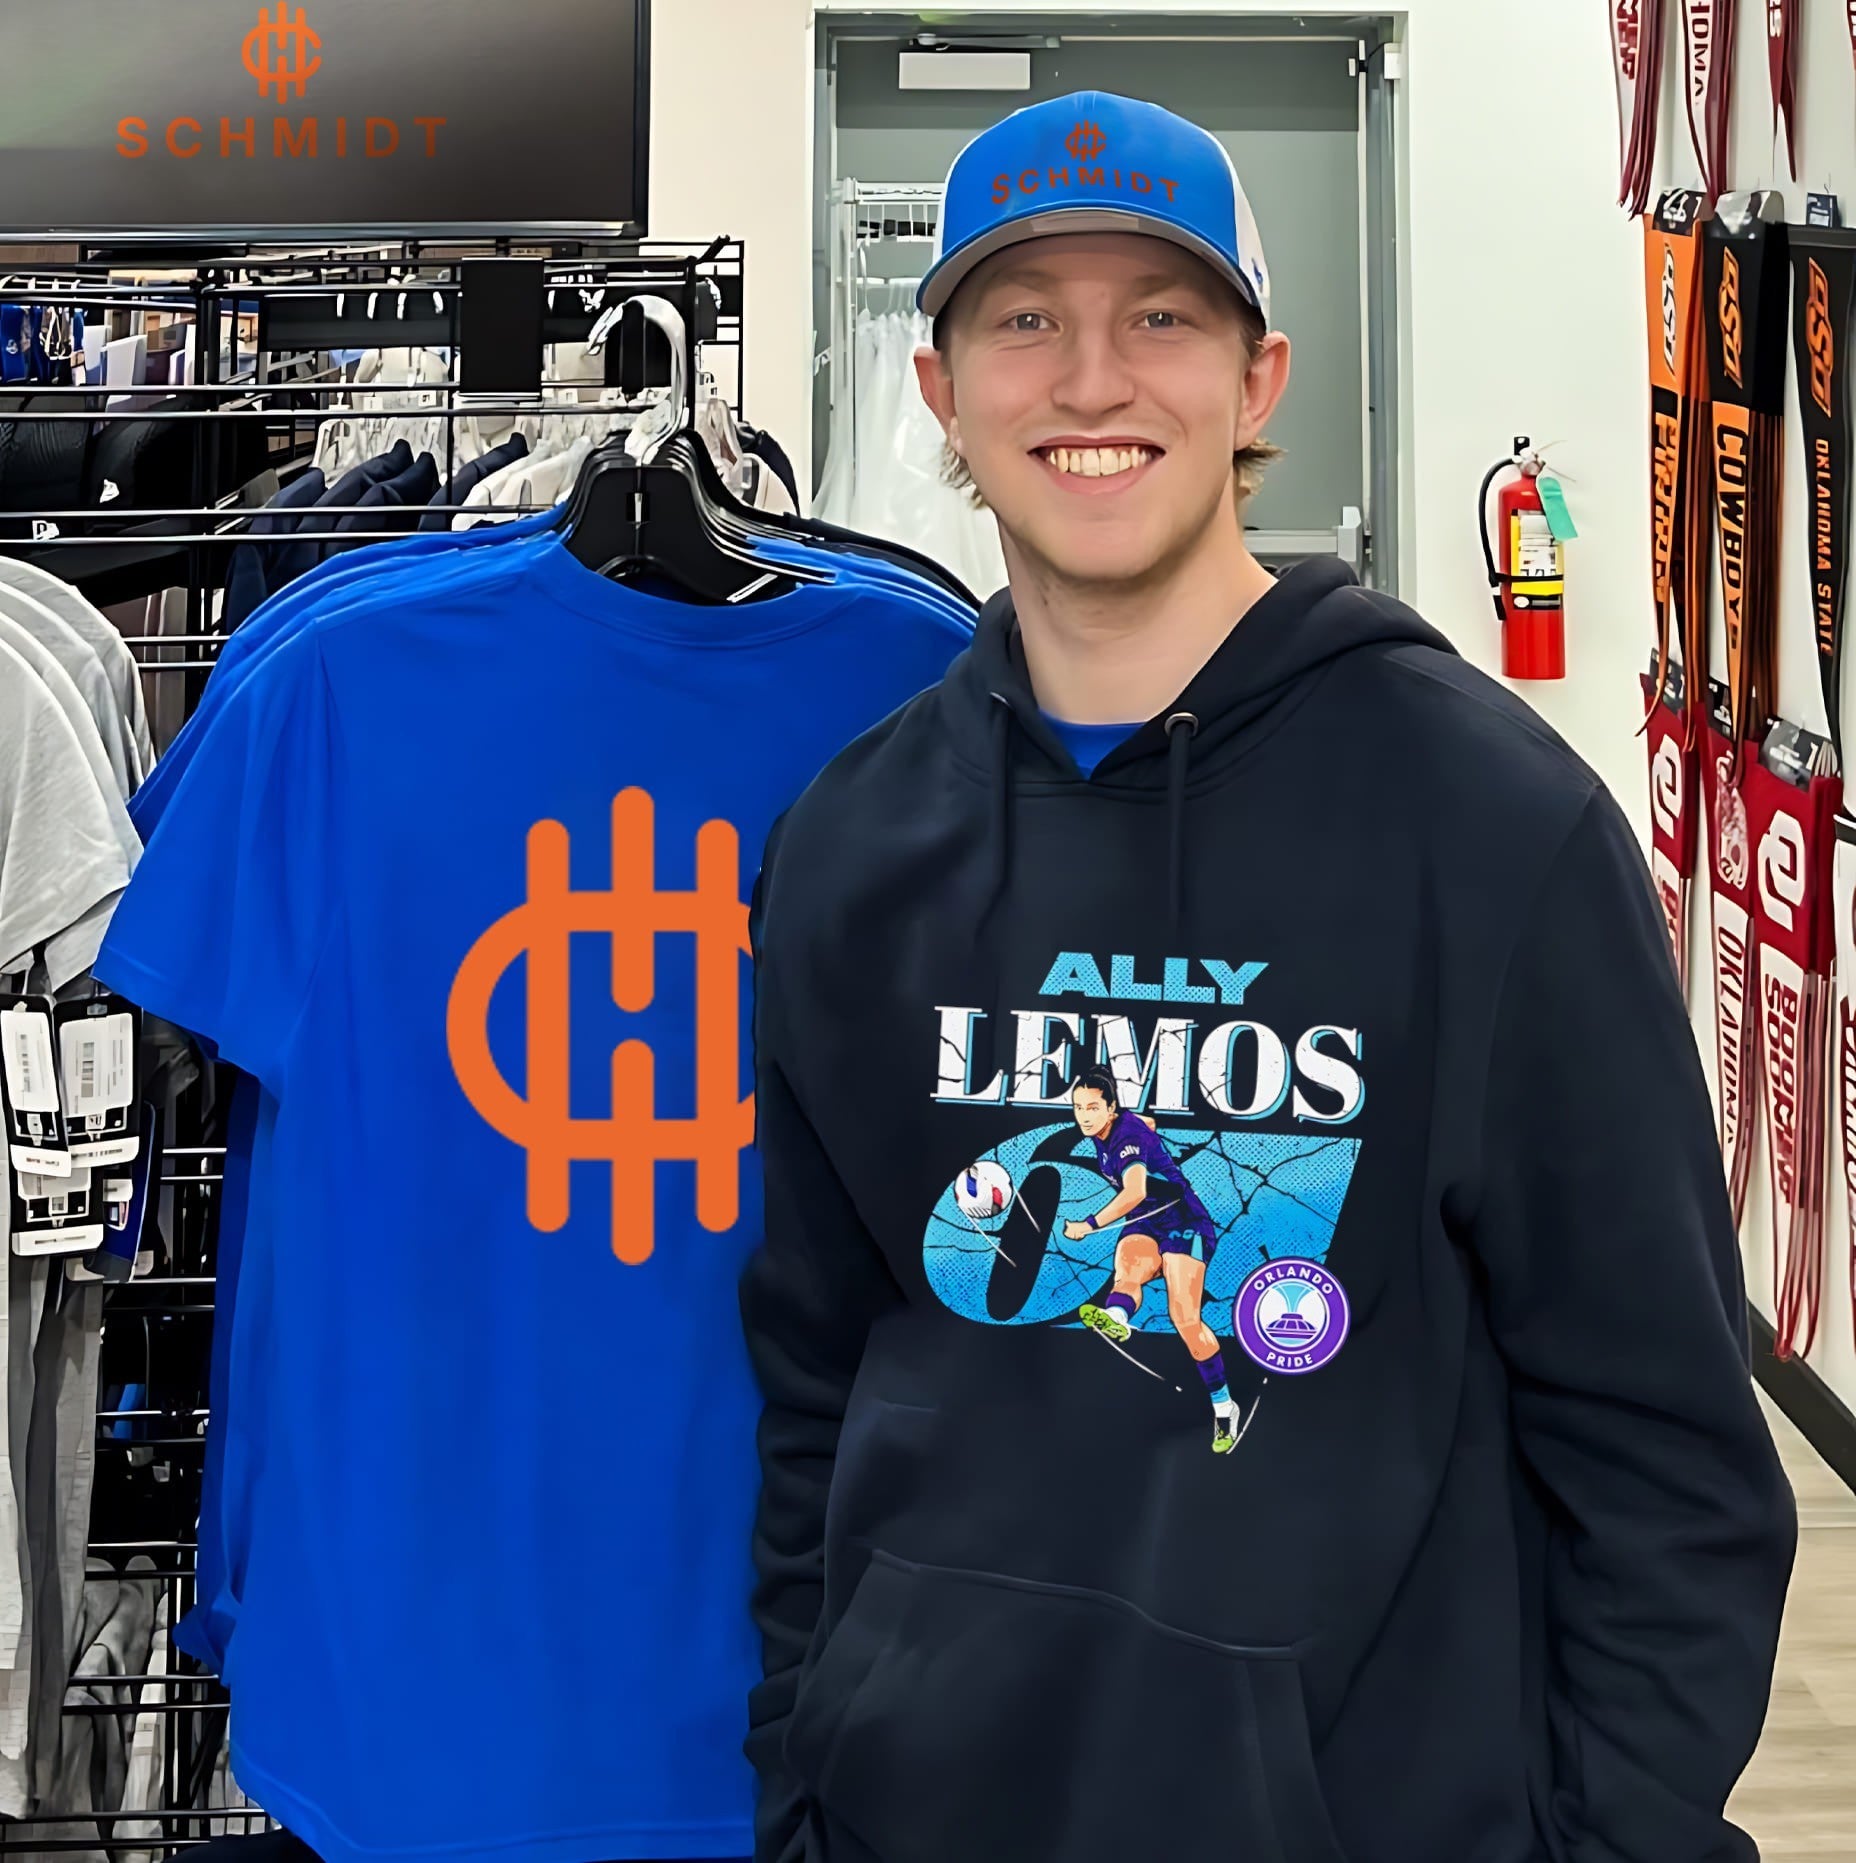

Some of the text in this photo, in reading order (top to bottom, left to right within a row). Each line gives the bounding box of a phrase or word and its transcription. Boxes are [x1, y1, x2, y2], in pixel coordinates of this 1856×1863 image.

[116, 118, 447, 158] SCHMIDT
[991, 167, 1179, 205] SCHMIDT
[1038, 951, 1269, 1005] ALLY
[930, 1006, 1366, 1124] LEMOS
[1119, 1144, 1140, 1159] ally
[1253, 1266, 1333, 1294] ORLANDO
[1266, 1351, 1313, 1368] PRIDE
